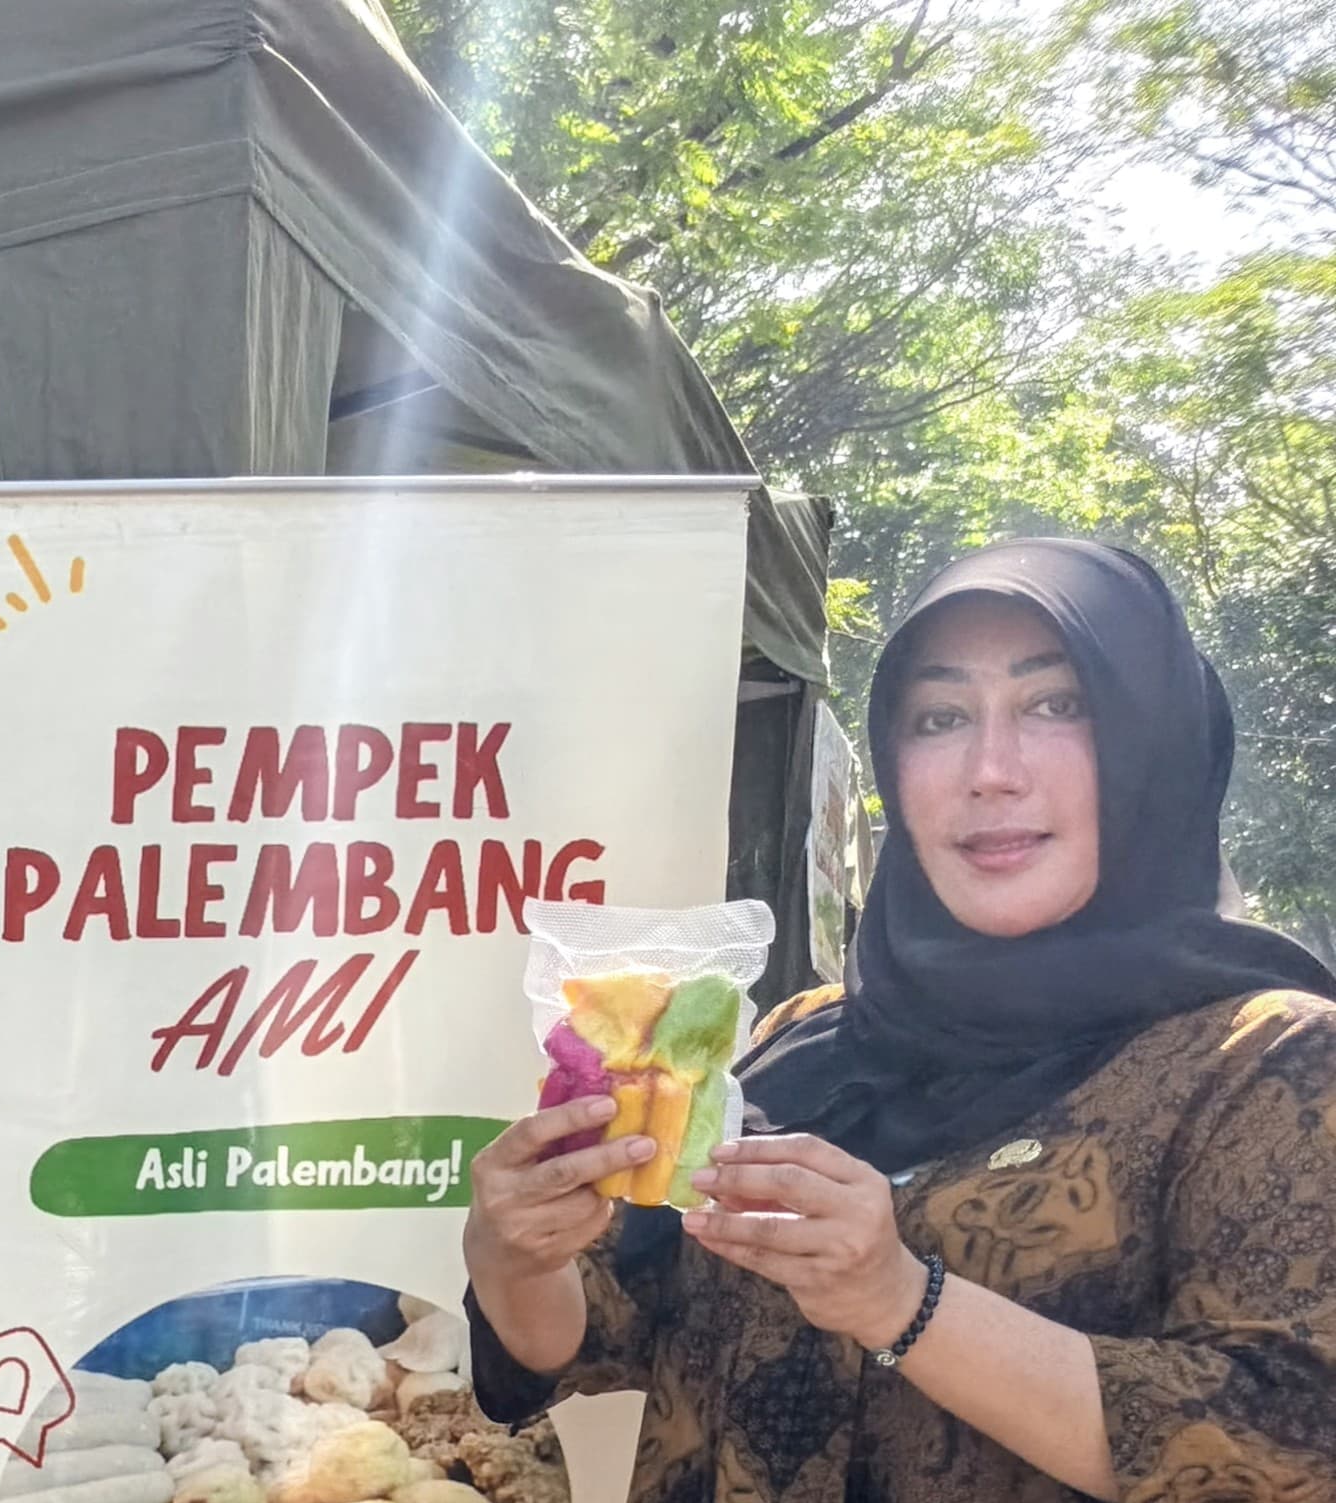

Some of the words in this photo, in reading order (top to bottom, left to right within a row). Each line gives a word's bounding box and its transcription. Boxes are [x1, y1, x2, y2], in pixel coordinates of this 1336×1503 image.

[110, 721, 512, 824] PEMPEK
[2, 838, 606, 942] PALEMBANG
[150, 950, 420, 1076] AMI
[136, 1141, 208, 1191] Asli
[227, 1138, 462, 1203] Palembang!
